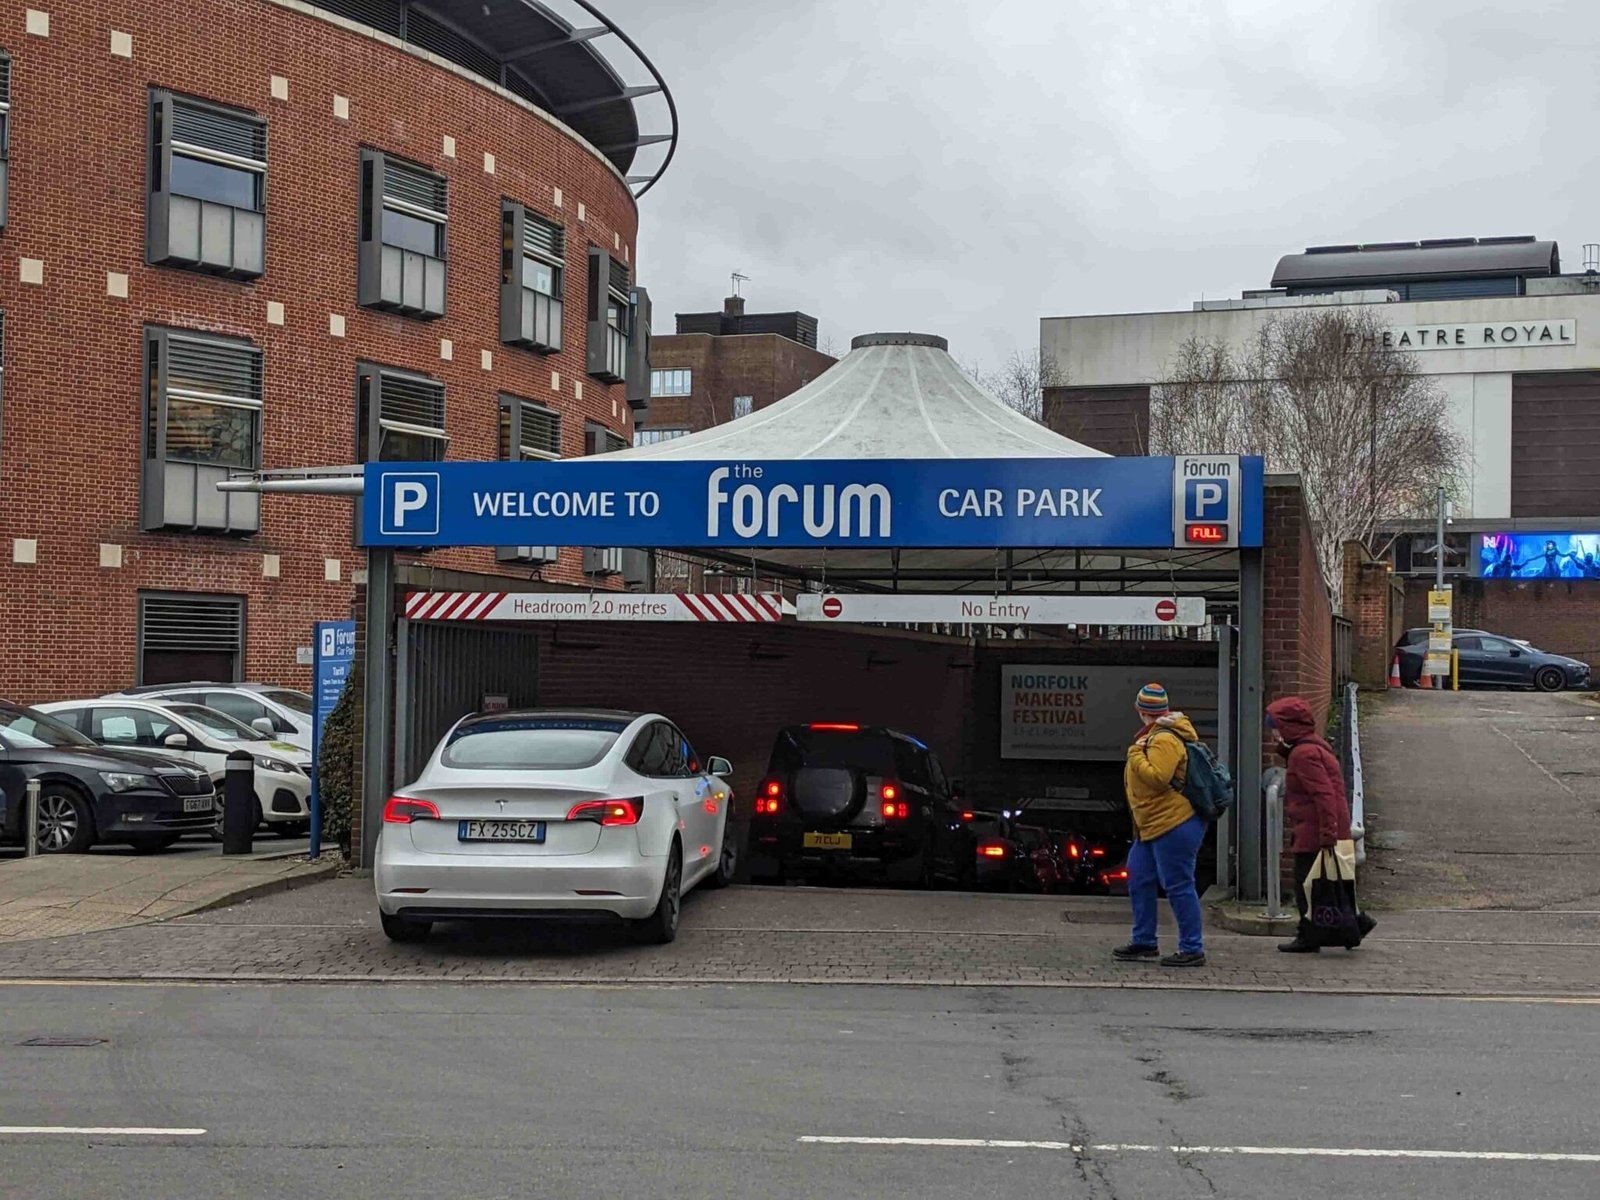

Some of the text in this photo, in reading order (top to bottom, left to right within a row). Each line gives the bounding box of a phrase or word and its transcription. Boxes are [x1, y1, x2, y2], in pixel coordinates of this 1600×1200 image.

[1484, 325, 1570, 342] ROYAL
[1184, 459, 1230, 476] forum
[394, 482, 428, 527] P
[473, 464, 1103, 538] WELCOME TO the forum CAR PARK
[1195, 483, 1222, 517] P
[1192, 527, 1222, 539] FULL
[514, 599, 667, 615] Headroom 2.0 metres
[961, 601, 1030, 621] No Entry
[325, 634, 332, 652] P
[337, 646, 355, 656] Car Par
[1012, 675, 1088, 690] NORFOLK
[1014, 692, 1084, 707] MAKERS
[1013, 710, 1086, 724] FESTIVAL
[468, 822, 537, 838] FX 255CZ
